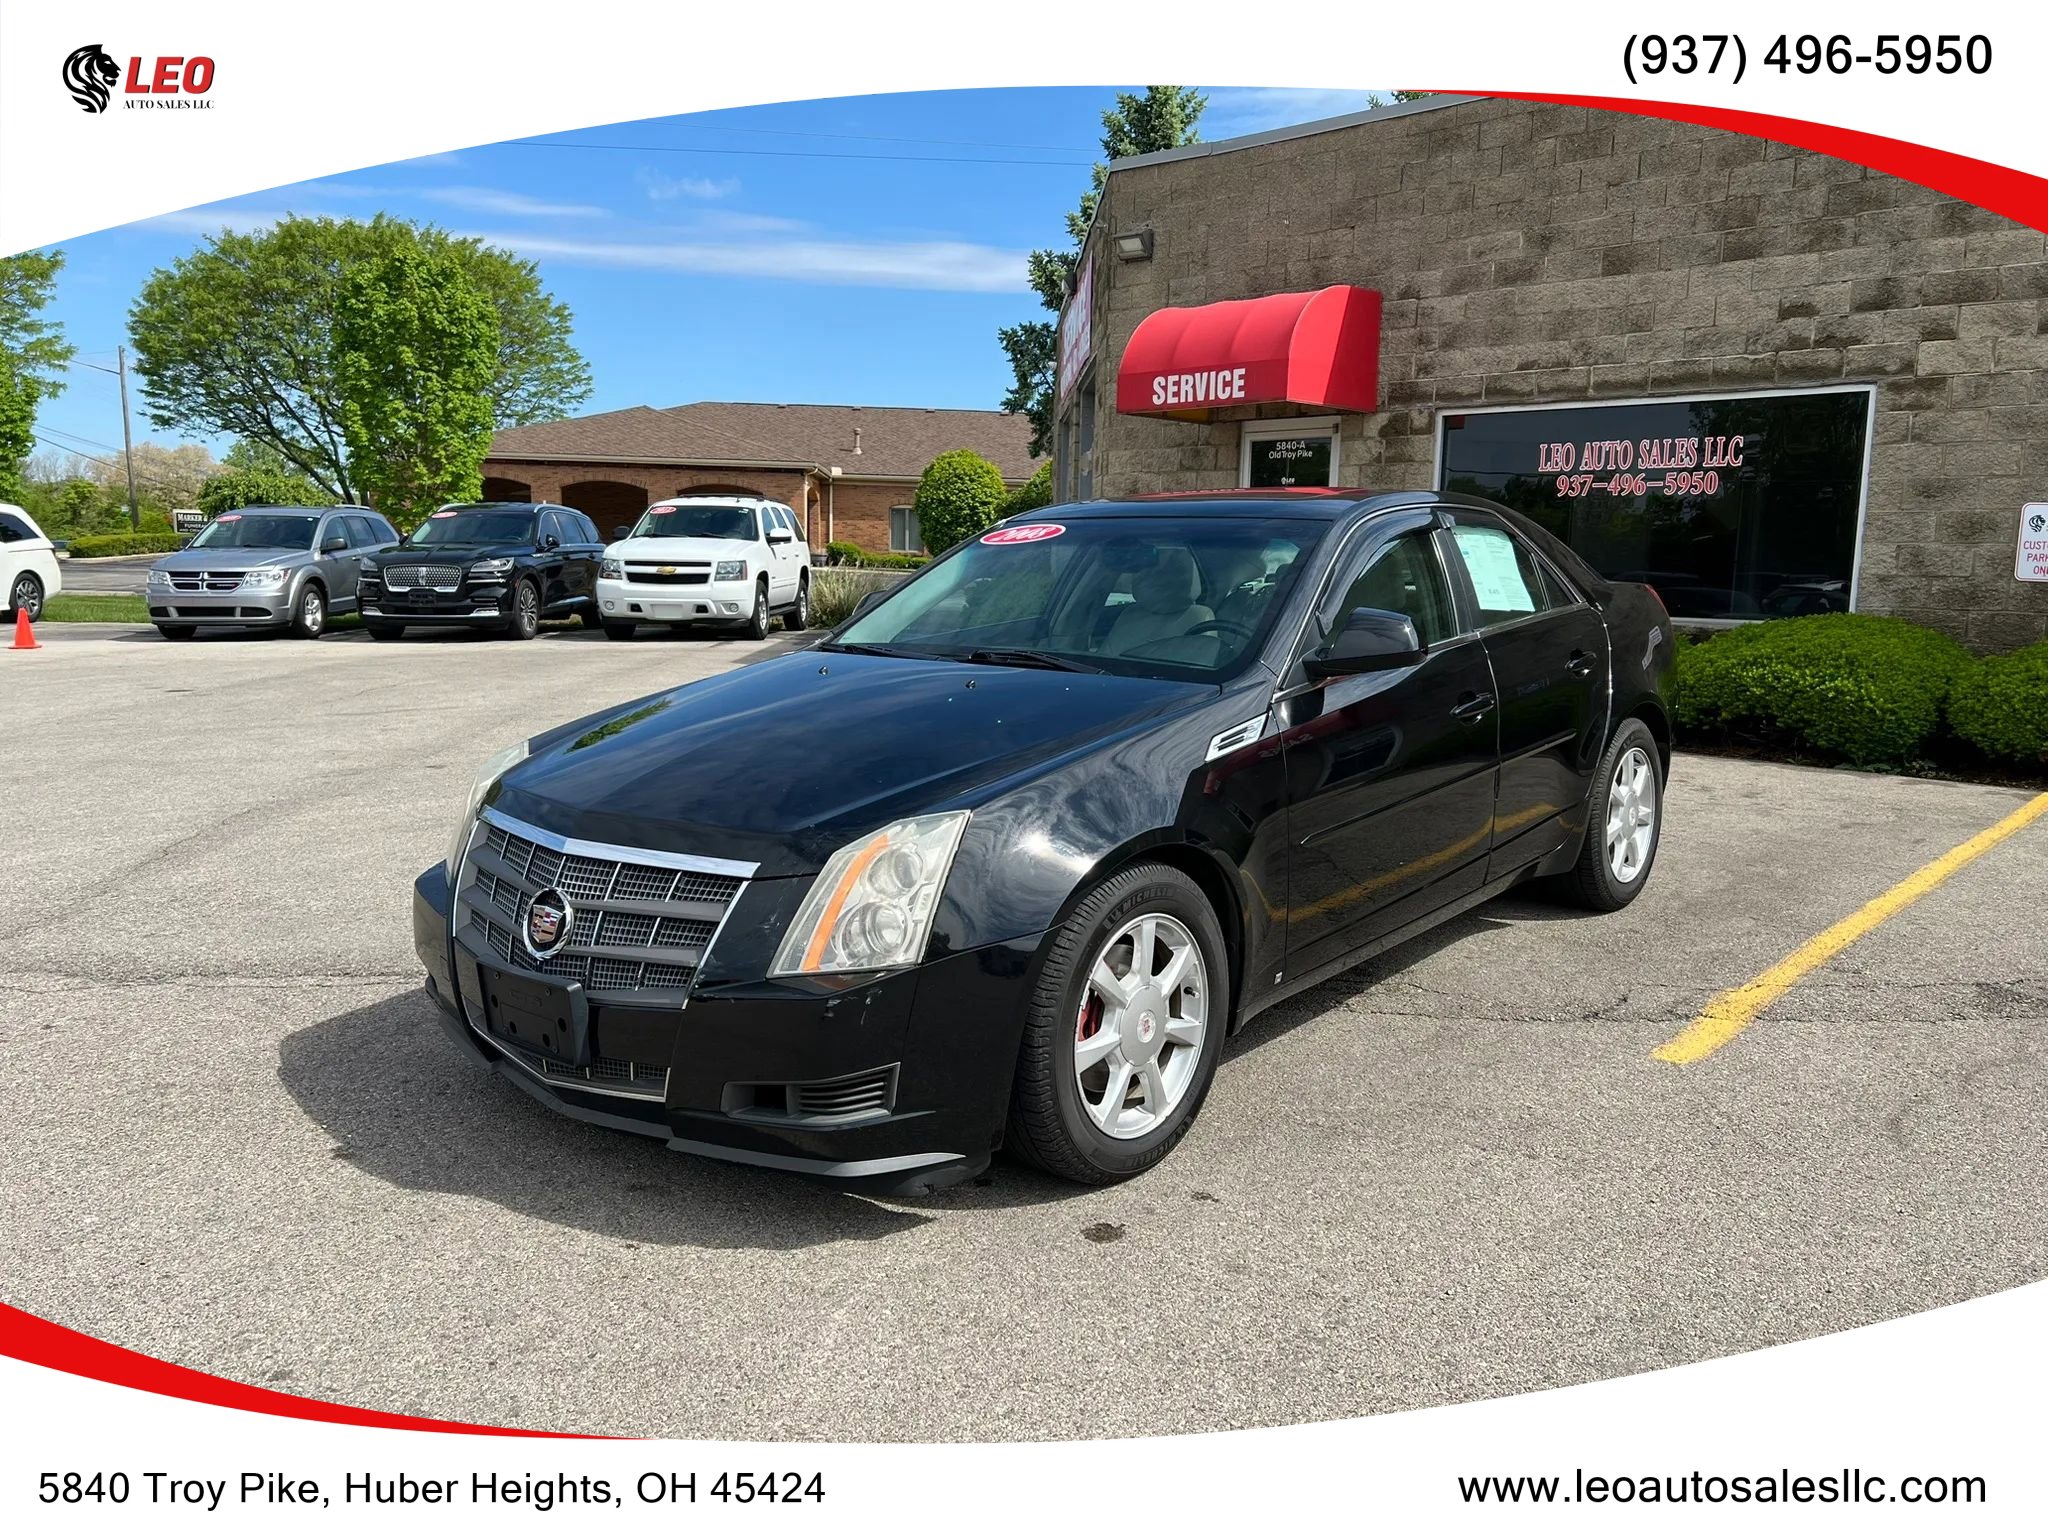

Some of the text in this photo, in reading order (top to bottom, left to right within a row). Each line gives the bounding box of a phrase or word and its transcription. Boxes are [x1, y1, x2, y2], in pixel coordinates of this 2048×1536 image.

[1152, 368, 1246, 405] SERVICE
[1268, 449, 1313, 460] Old Troy Pike
[1276, 440, 1306, 451] 5840-A
[1538, 435, 1744, 472] LEO AUTO SALES LLC
[1556, 471, 1719, 497] 937-496-5950
[2023, 540, 2048, 550] CUST
